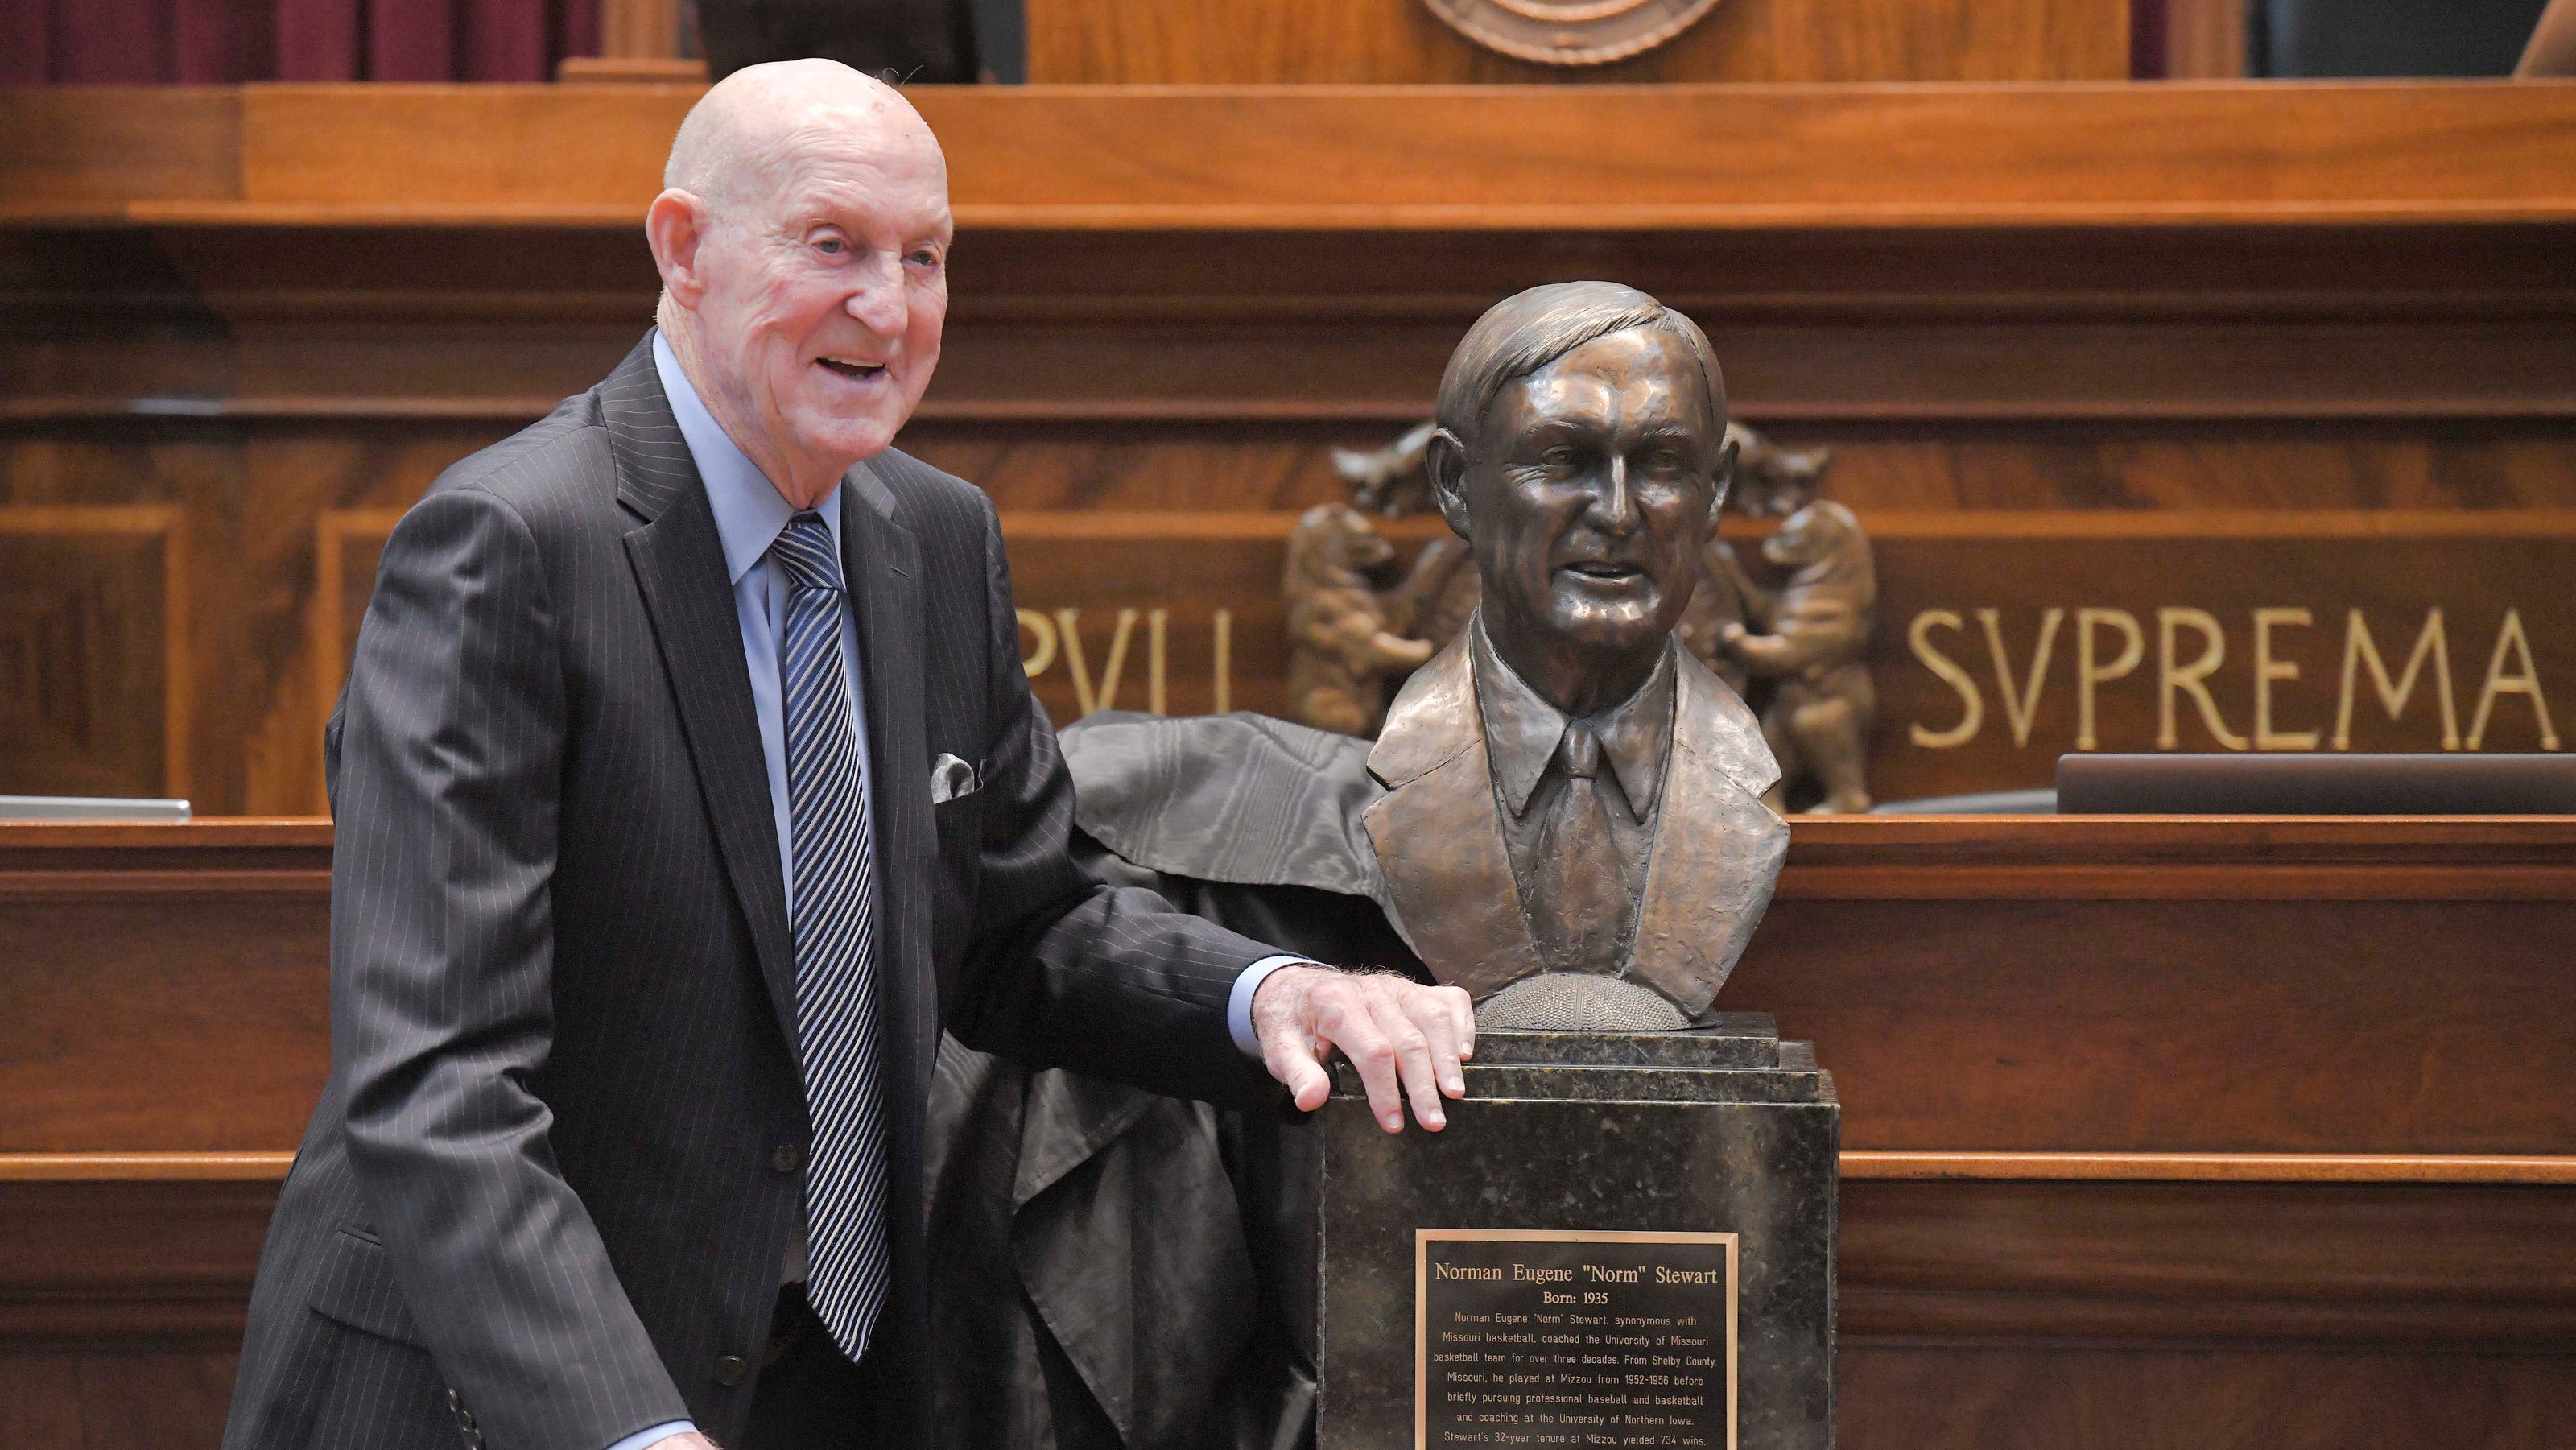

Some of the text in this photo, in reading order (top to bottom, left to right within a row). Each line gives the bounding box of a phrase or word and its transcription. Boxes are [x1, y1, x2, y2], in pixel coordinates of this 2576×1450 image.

[1907, 607, 2561, 751] SVPREMA
[1435, 1262, 1719, 1285] Norman Eugene "Norm" Stewart
[1542, 1291, 1608, 1304] Born: 1935
[1455, 1311, 1490, 1323] Norman
[1495, 1312, 1528, 1325] Eugene
[1614, 1316, 1671, 1328] synonymous
[1676, 1316, 1697, 1326] with
[1443, 1331, 1480, 1342] Missouri
[1542, 1332, 1580, 1344] coached
[1585, 1333, 1600, 1345] the
[1605, 1333, 1650, 1347] University
[1655, 1335, 1666, 1345] of
[1670, 1335, 1709, 1346] Missouri
[1433, 1351, 1479, 1362] basketball
[1484, 1353, 1506, 1362] team
[1511, 1352, 1525, 1362] for
[1529, 1354, 1549, 1363] over
[1554, 1353, 1577, 1364] three
[1624, 1353, 1648, 1365] From
[1652, 1353, 1681, 1368] Shelby
[1492, 1372, 1504, 1382] he
[1509, 1372, 1540, 1386] played
[1545, 1373, 1555, 1383] at
[1560, 1372, 1592, 1385] Mizzou
[1597, 1373, 1620, 1385] from
[1624, 1374, 1669, 1386] 1952-1956
[1674, 1374, 1704, 1386] before
[1447, 1390, 1703, 1406] briefly pursuing professional baseball and basketball
[1456, 1411, 1473, 1422] and
[1478, 1411, 1519, 1424] coaching
[1522, 1413, 1534, 1423] at
[1539, 1412, 1554, 1423] the
[1559, 1412, 1604, 1426] University
[1610, 1414, 1620, 1424] of
[1624, 1414, 1665, 1425] Northern
[1444, 1431, 1489, 1442] Stewart's
[1494, 1431, 1531, 1444] 32-year
[1536, 1433, 1565, 1443] tenure
[1571, 1434, 1580, 1444] at
[1586, 1432, 1617, 1444] Mizzou
[1623, 1434, 1655, 1448] yielded
[1660, 1435, 1677, 1445] 734
